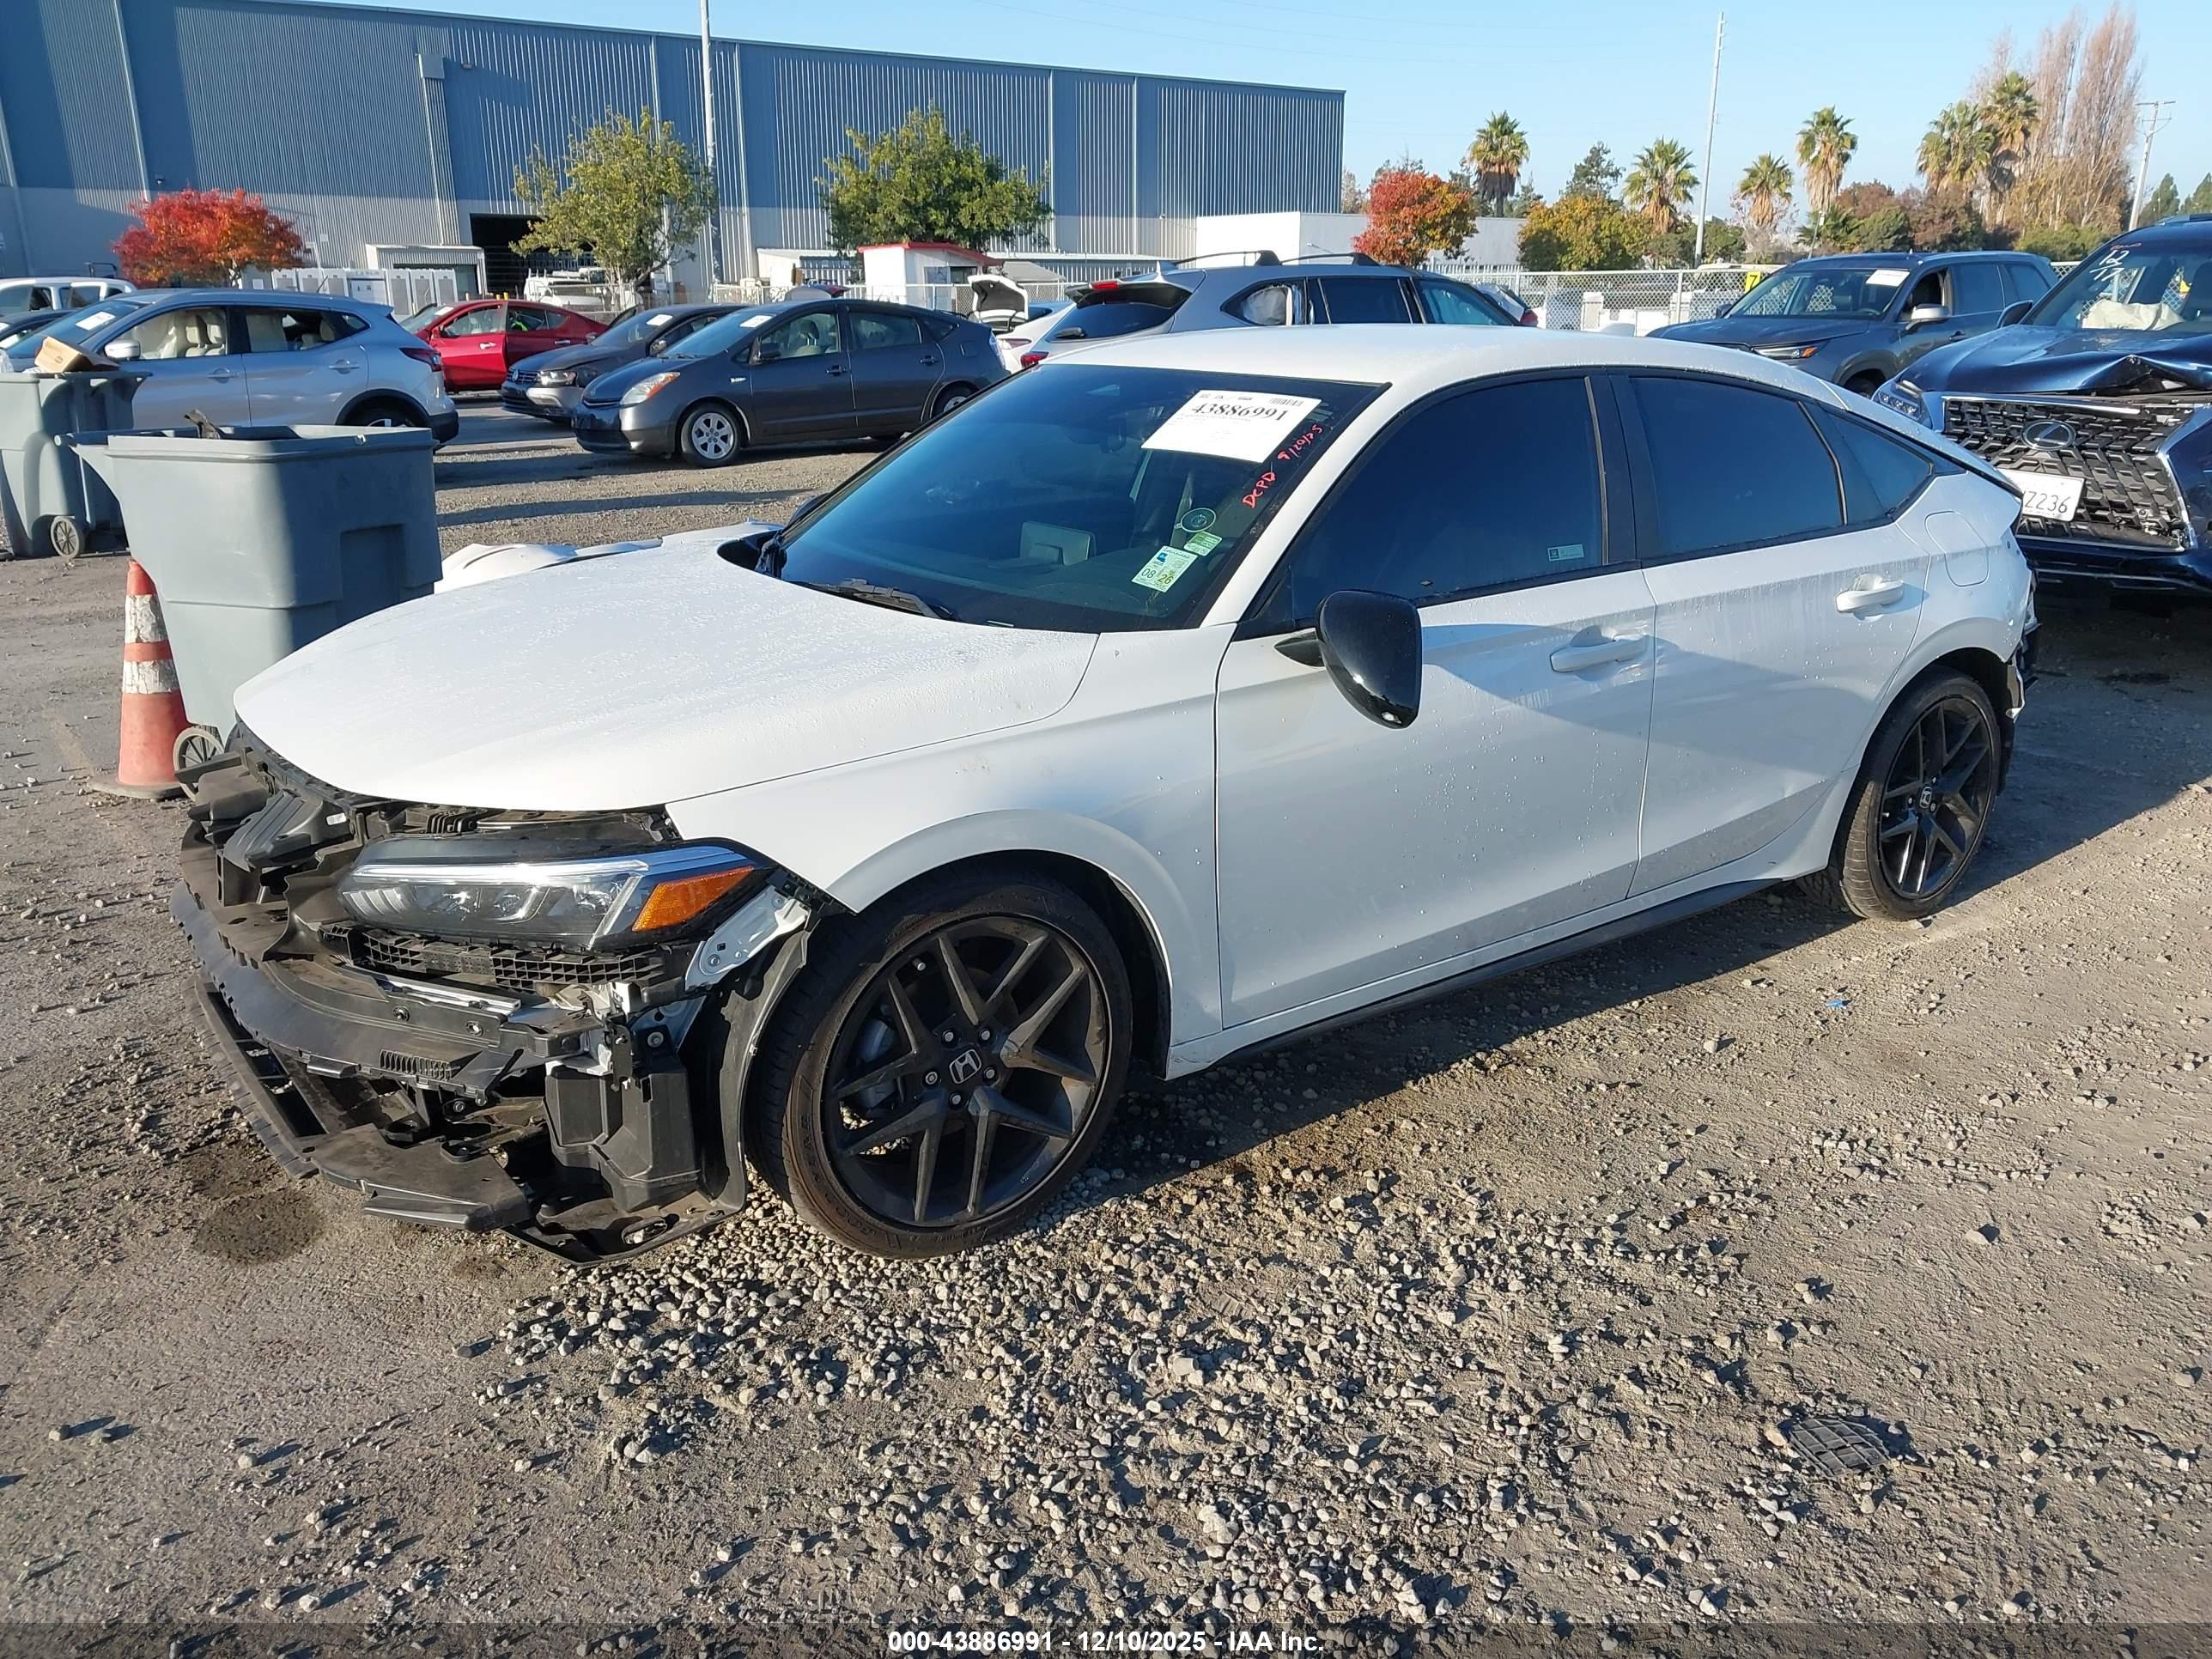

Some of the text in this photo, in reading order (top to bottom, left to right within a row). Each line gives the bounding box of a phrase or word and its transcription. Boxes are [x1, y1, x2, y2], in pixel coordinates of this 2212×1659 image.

[2098, 250, 2130, 265] 12
[1749, 274, 1759, 289] 7
[1192, 402, 1289, 421] 43886991
[1141, 568, 1157, 579] 08
[1158, 574, 1174, 585] 26
